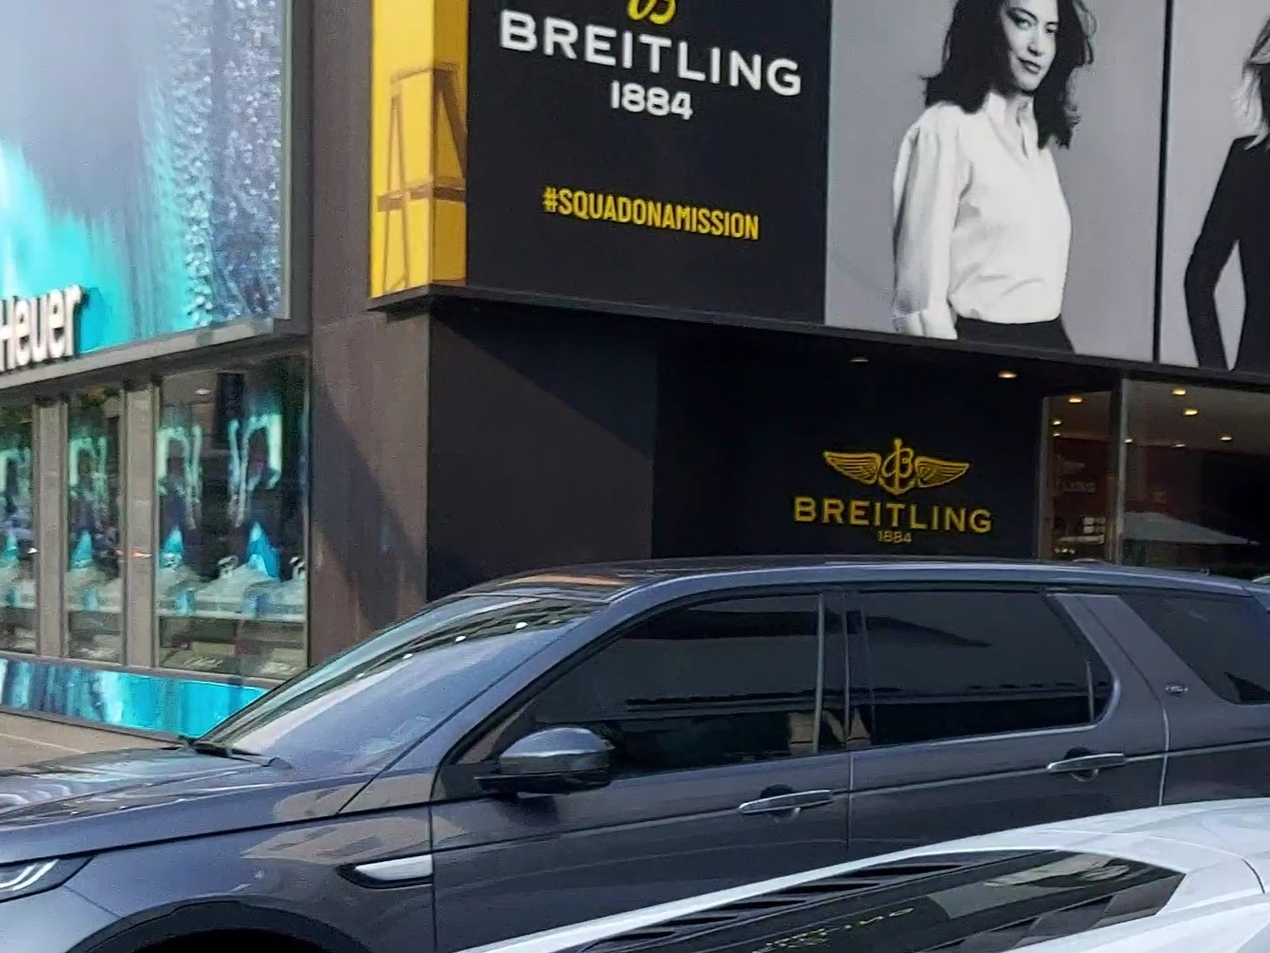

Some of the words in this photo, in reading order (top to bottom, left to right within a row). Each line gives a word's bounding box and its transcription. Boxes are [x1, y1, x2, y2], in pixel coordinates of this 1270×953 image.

[501, 9, 801, 96] BREITLING
[610, 80, 693, 120] 1884
[543, 186, 759, 240] #SQUADONAMISSION
[794, 496, 992, 533] BREITLING
[878, 530, 911, 543] 1884
